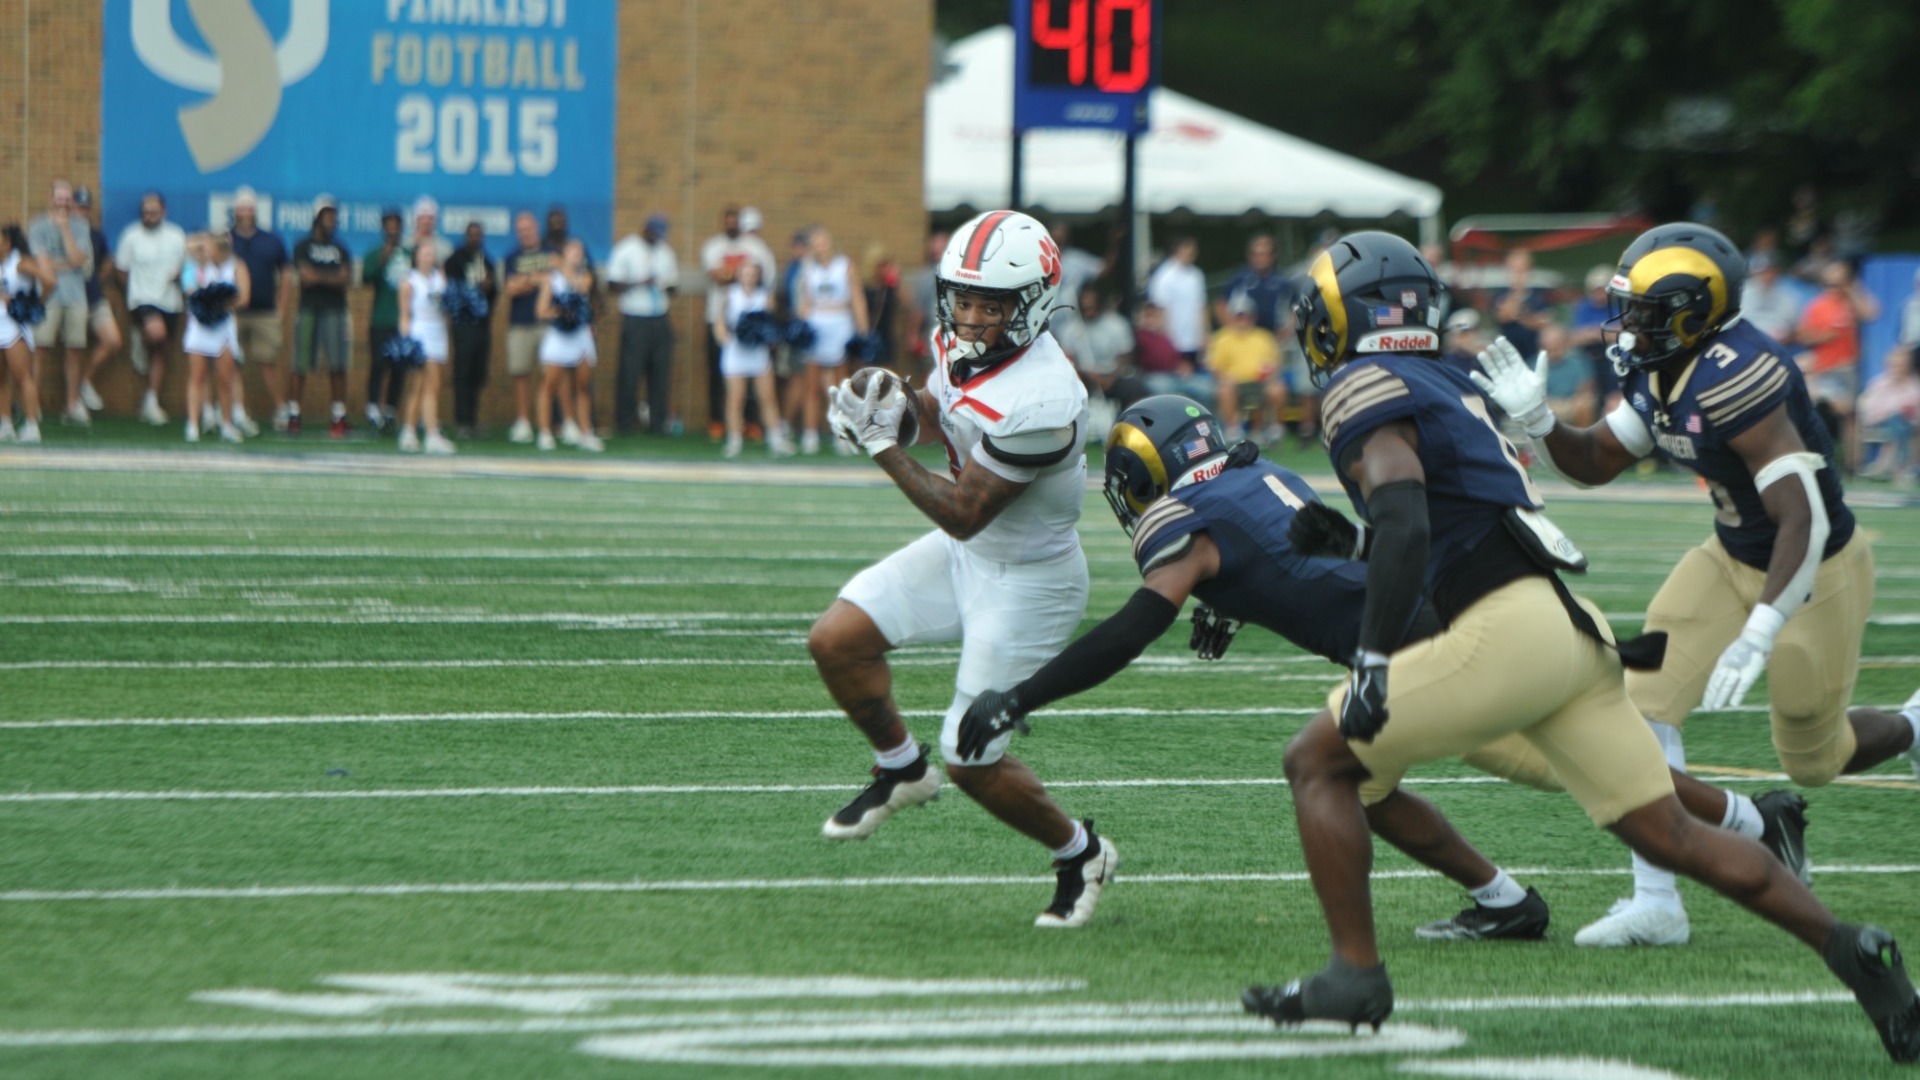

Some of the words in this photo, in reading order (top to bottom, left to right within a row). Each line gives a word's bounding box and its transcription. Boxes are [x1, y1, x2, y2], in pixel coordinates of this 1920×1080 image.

[371, 31, 585, 91] FOOTBALL
[1032, 0, 1151, 93] 40
[395, 94, 559, 177] 2015
[1379, 335, 1432, 349] Riddell
[1704, 342, 1739, 369] 3
[1194, 461, 1226, 483] Ridd
